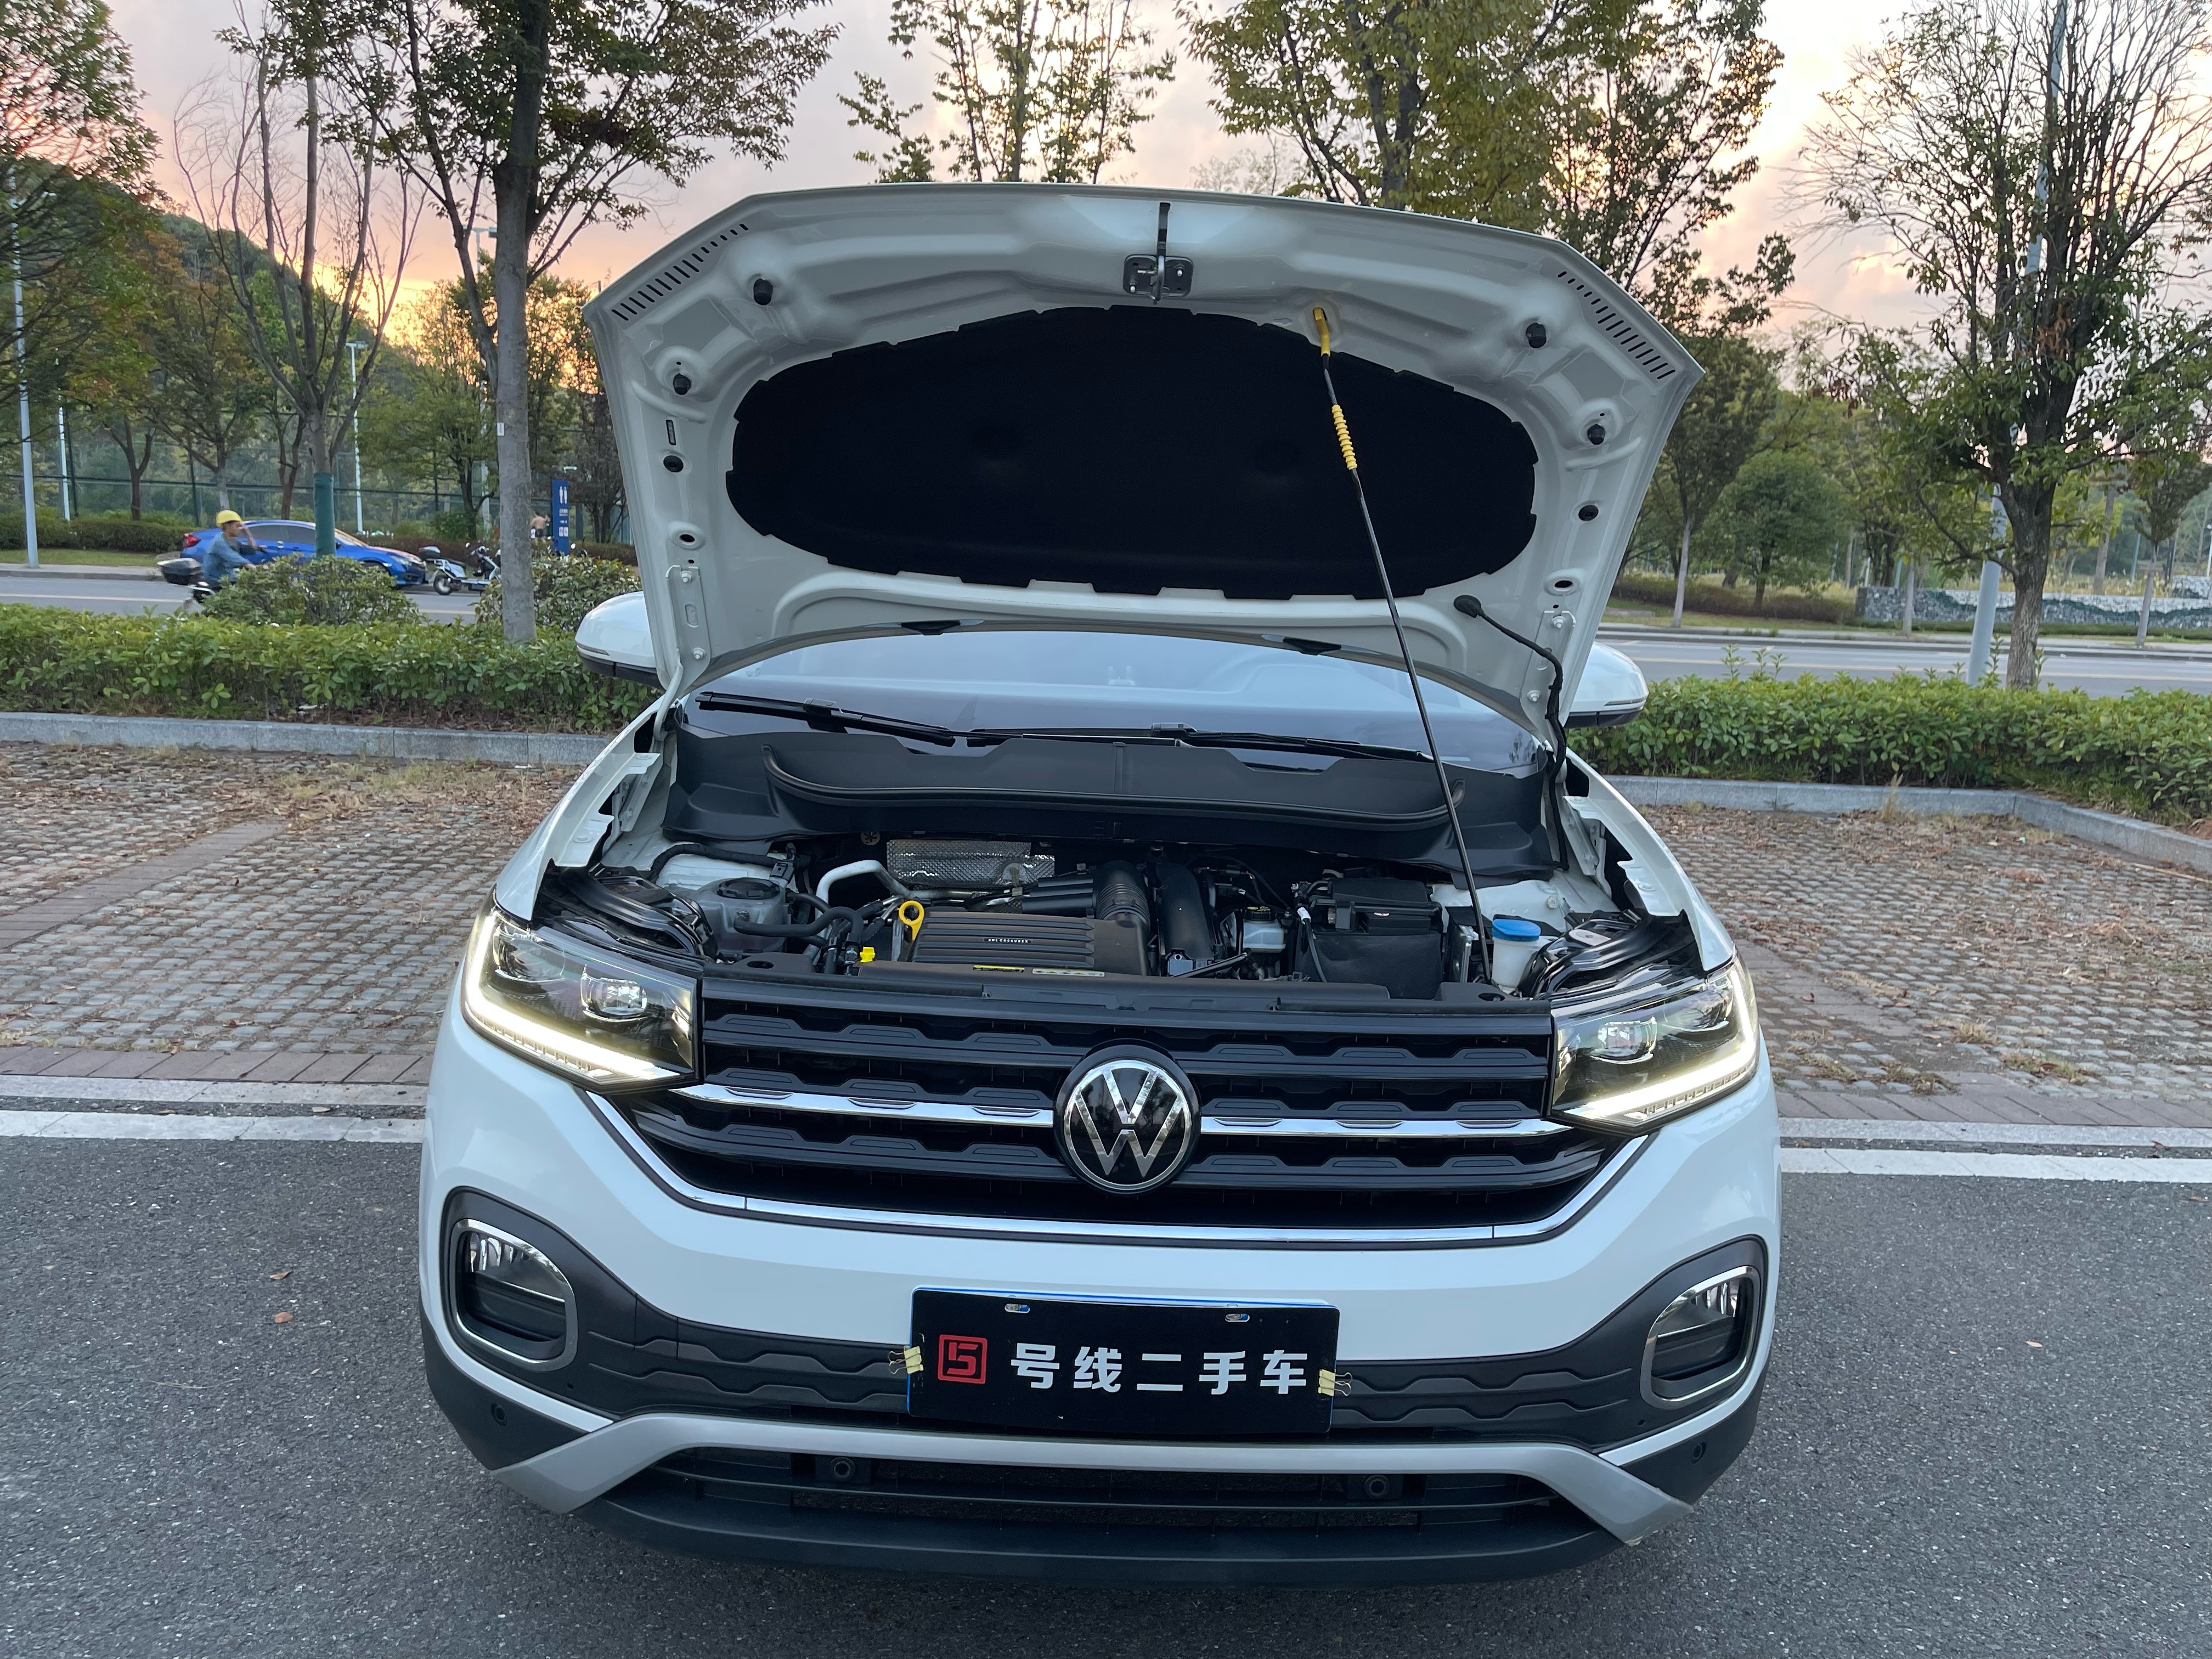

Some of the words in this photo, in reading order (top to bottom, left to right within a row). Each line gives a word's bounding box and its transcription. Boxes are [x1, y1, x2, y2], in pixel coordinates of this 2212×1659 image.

[1073, 1065, 1184, 1179] VW
[1011, 1342, 1308, 1395] 号线二手车
